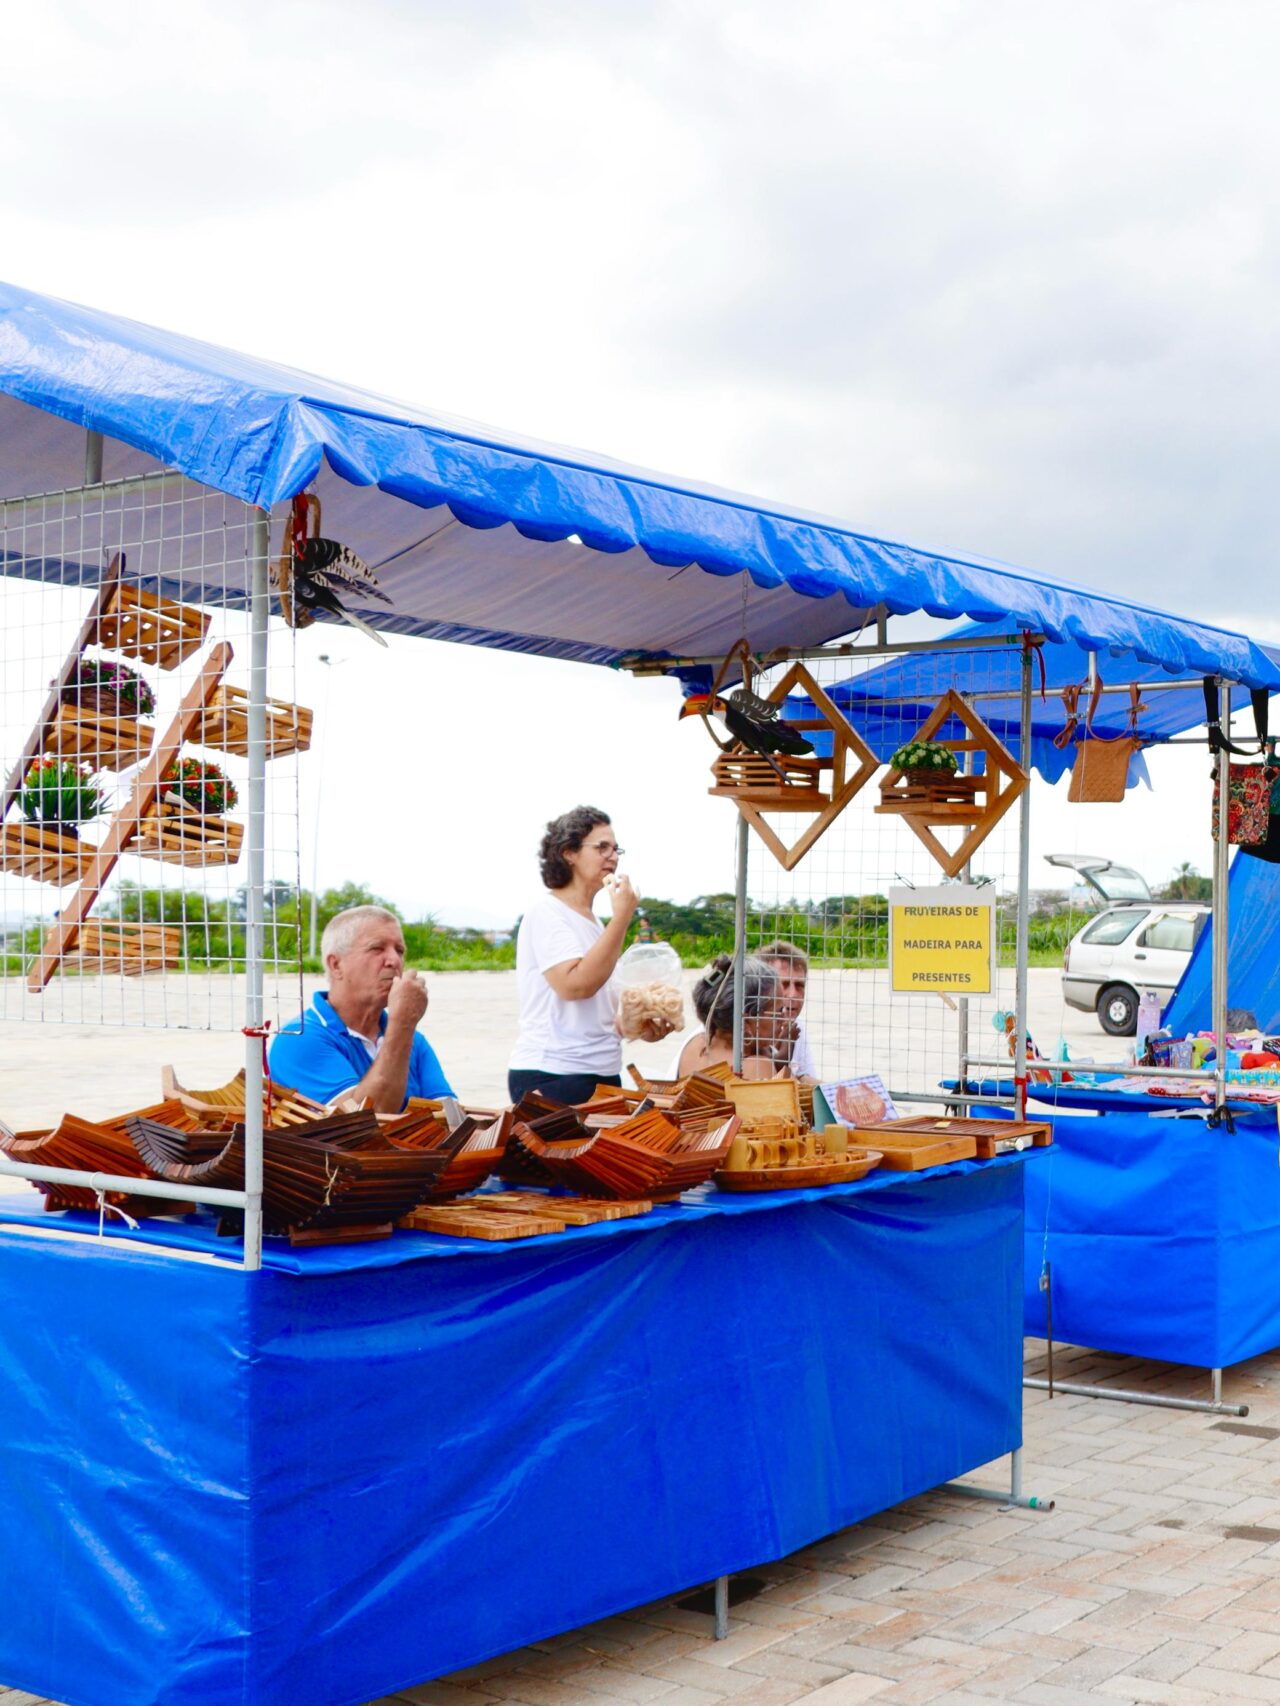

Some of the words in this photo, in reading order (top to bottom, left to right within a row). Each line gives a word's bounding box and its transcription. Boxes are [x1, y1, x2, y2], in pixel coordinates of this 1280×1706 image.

[965, 906, 979, 917] DE
[903, 940, 952, 950] MADEIRA
[955, 940, 983, 950] PARA
[912, 972, 971, 983] PRESENTES
